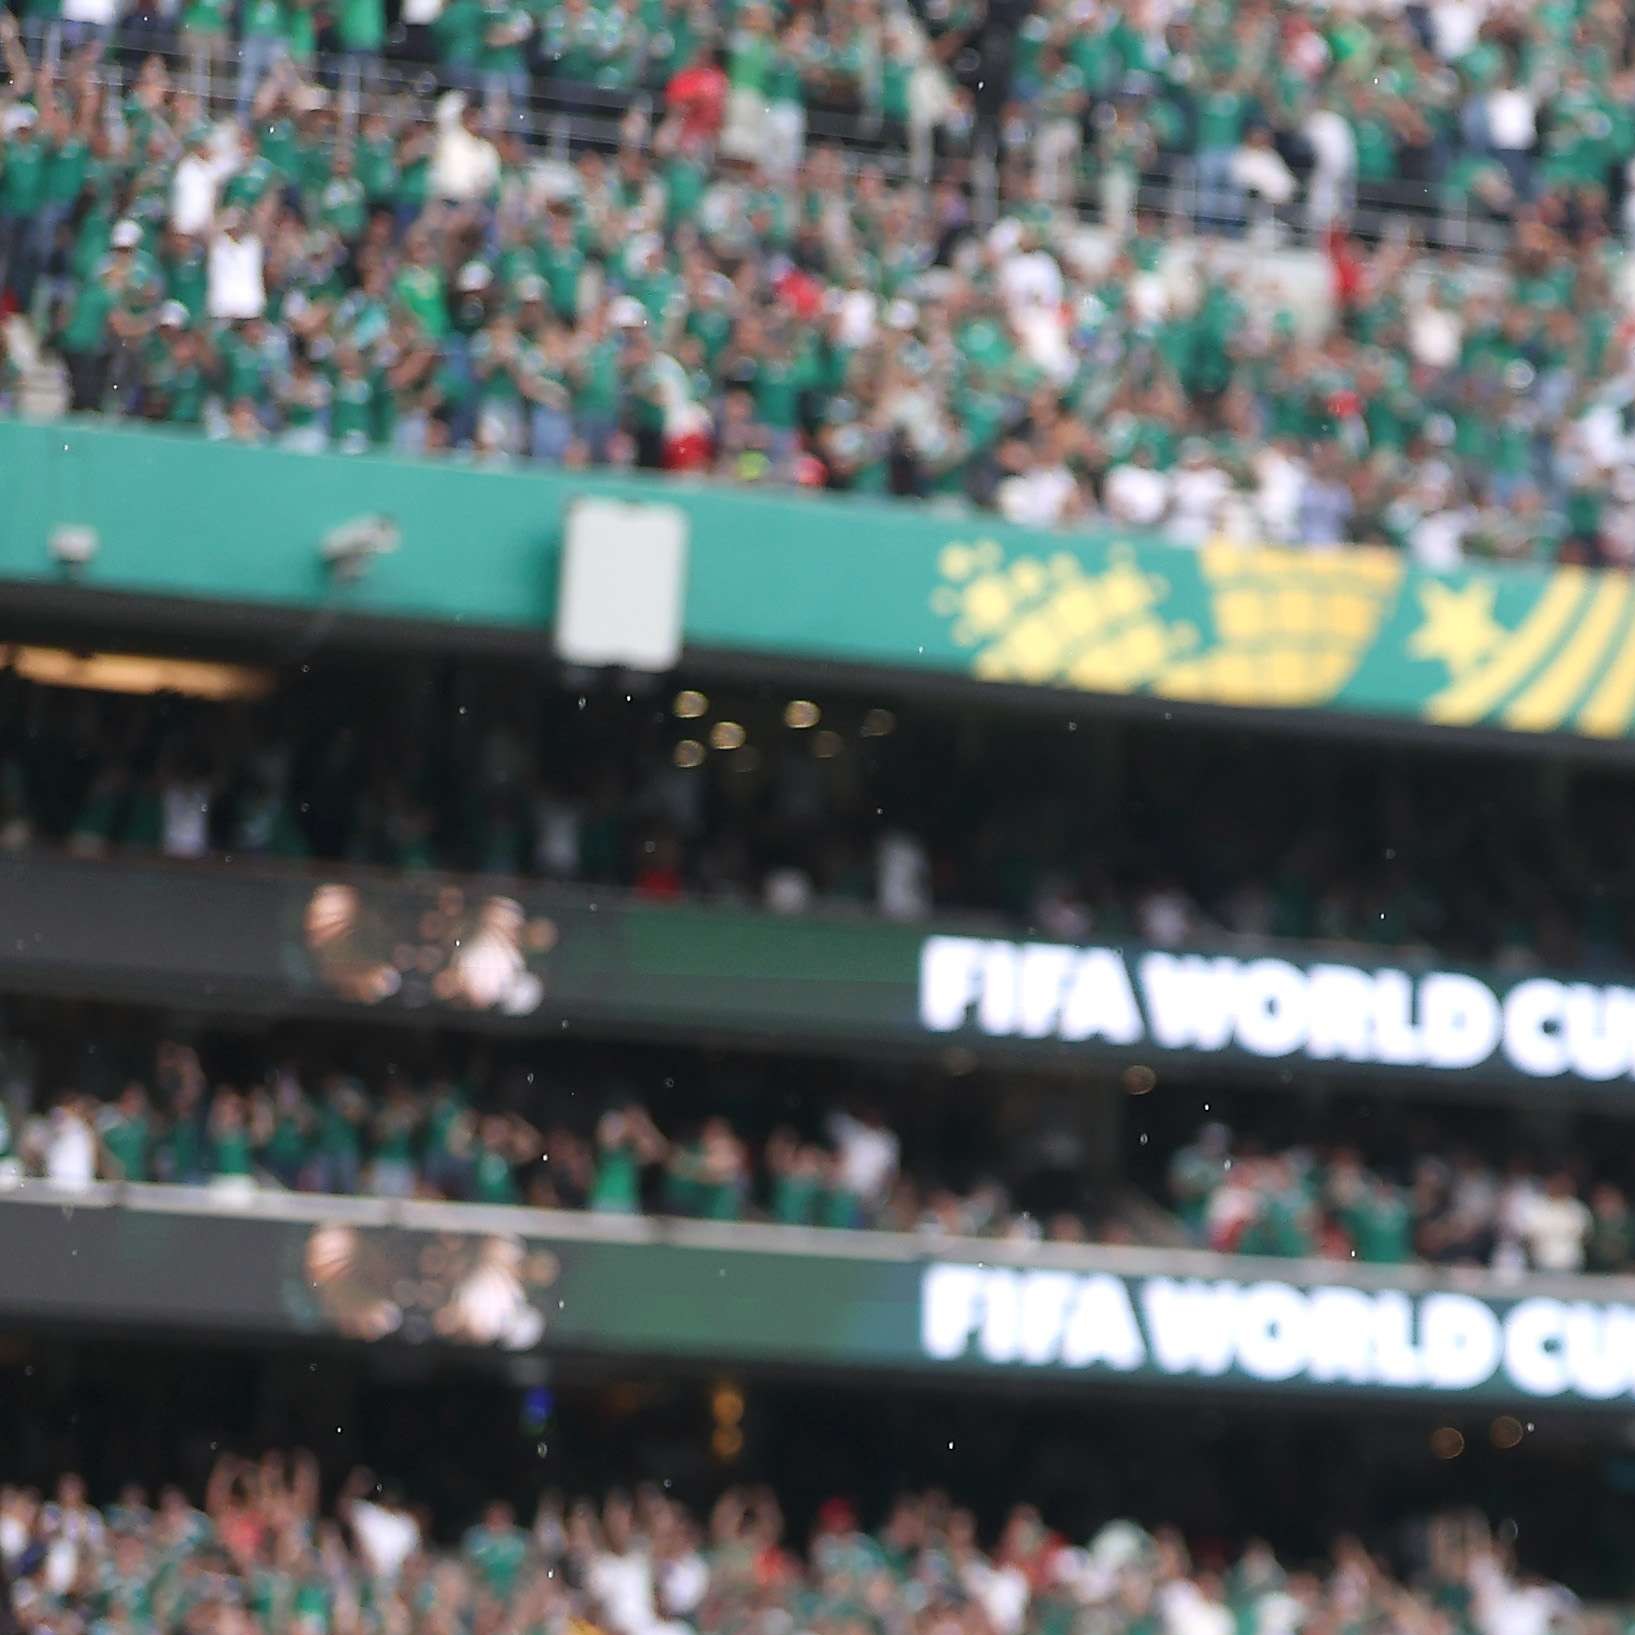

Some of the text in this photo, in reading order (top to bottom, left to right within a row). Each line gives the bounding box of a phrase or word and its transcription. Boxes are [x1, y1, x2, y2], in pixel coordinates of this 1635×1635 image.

[919, 935, 1144, 1043] FIFA
[1143, 951, 1500, 1070] WORLD
[919, 1262, 1145, 1370] FIFA
[1142, 1277, 1501, 1391] WORLD
